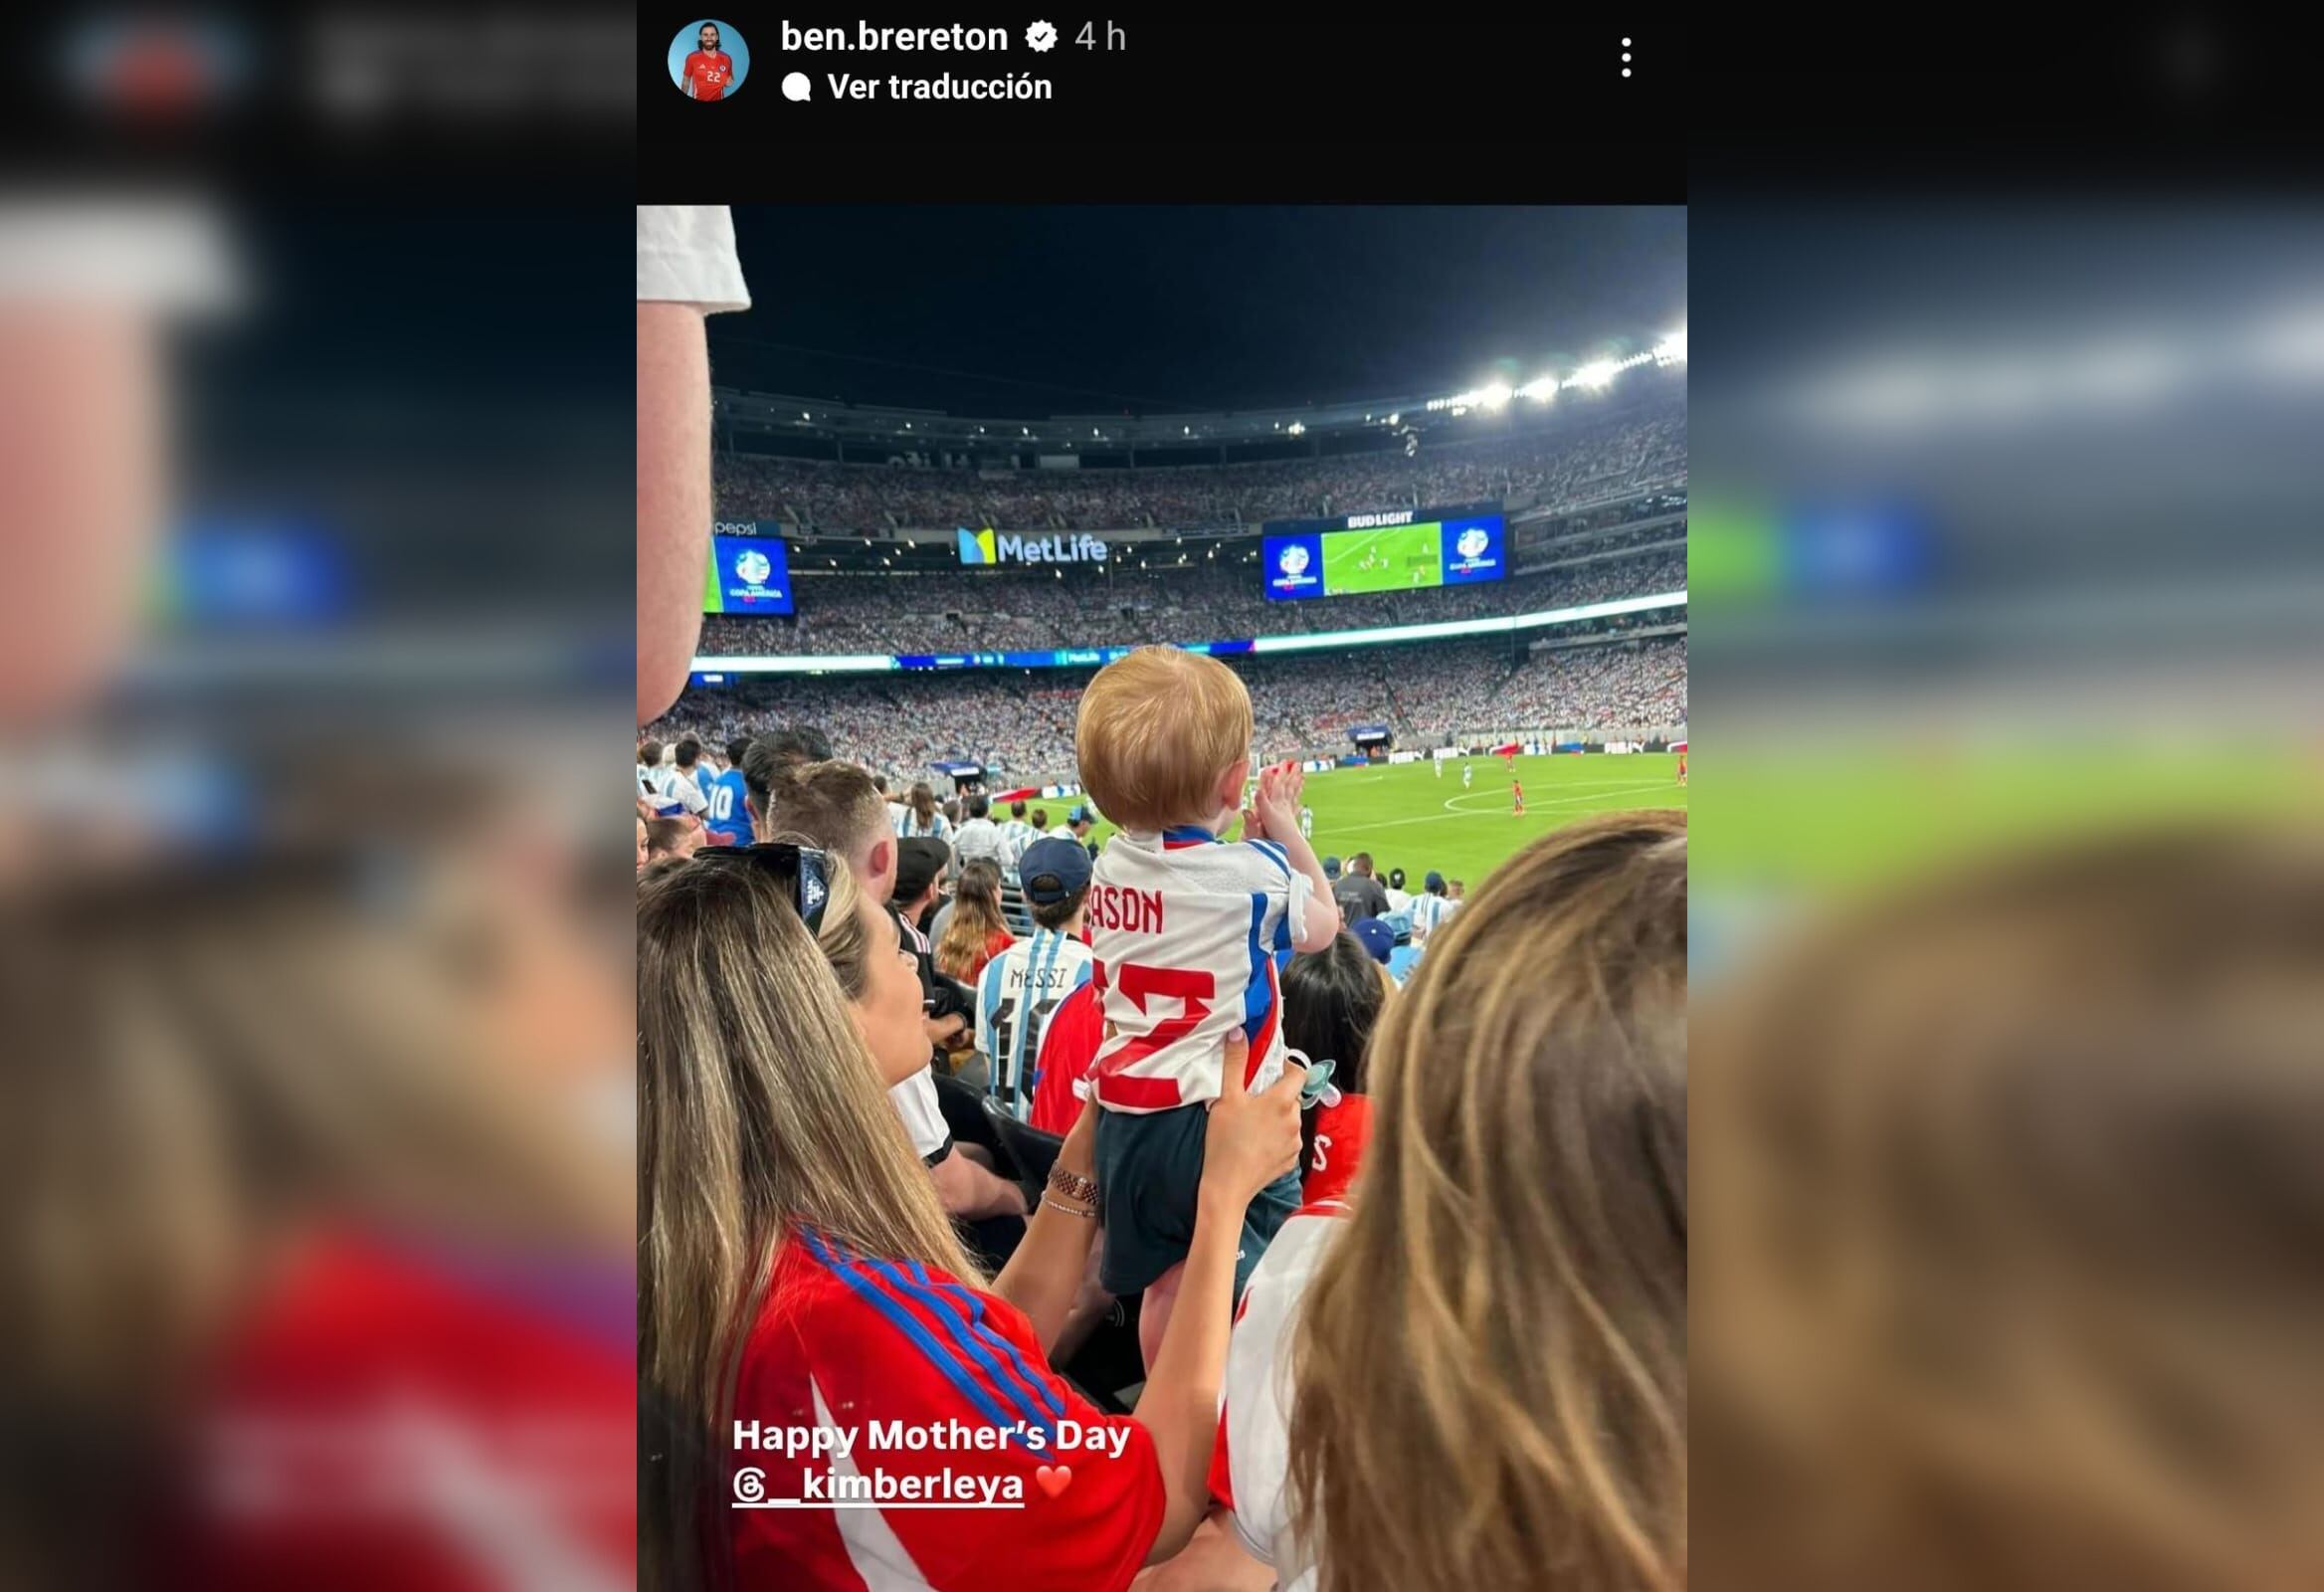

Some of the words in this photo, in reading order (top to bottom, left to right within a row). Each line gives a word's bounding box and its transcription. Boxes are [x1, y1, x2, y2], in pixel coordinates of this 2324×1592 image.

[706, 71, 721, 83] 22
[714, 521, 757, 536] pepsi
[1348, 514, 1376, 528] BUD
[1376, 510, 1414, 526] LIGHT
[997, 532, 1108, 562] MetLife
[707, 783, 733, 820] 10
[1010, 968, 1067, 989] MESSI
